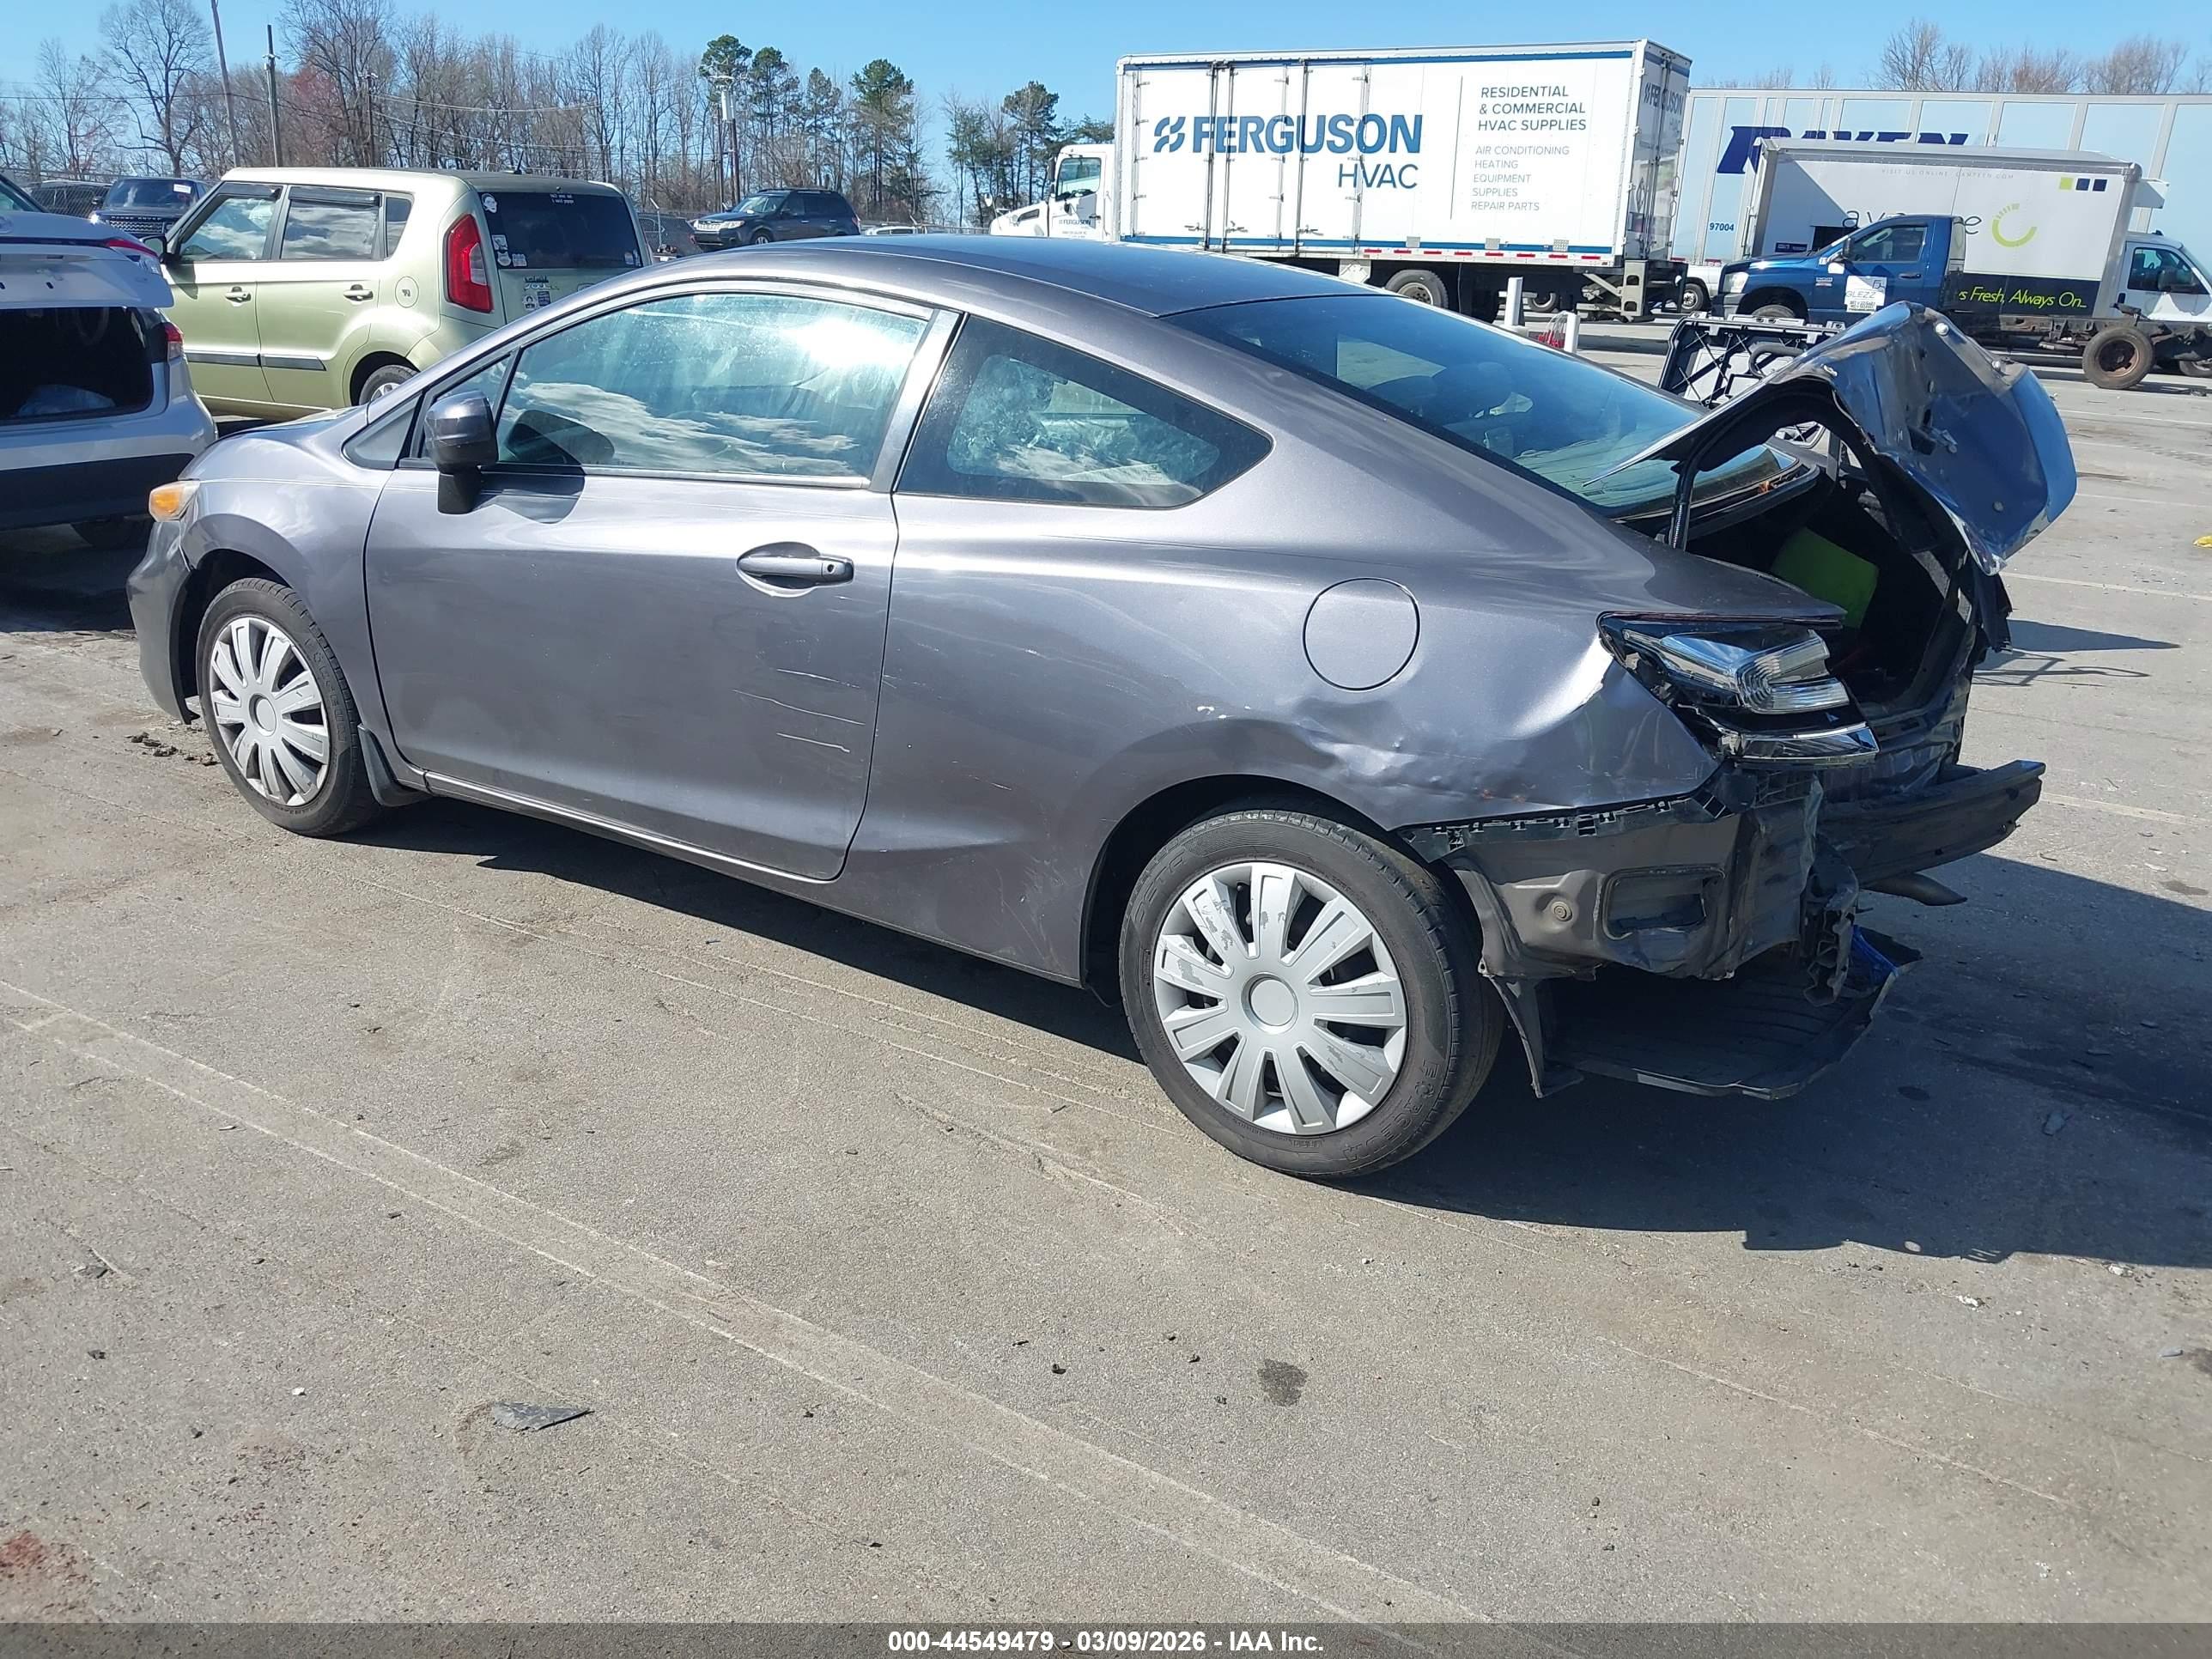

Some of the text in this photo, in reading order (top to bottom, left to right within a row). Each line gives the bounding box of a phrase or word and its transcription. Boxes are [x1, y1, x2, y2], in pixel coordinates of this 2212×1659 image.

[1480, 85, 1570, 99] RESIDENTIAL
[1479, 102, 1586, 114] & COMMERCIAL
[1478, 118, 1587, 131] HVAC SUPPLIES
[1192, 113, 1423, 154] FERGUSON
[1475, 145, 1571, 155] AIR CONDITIONING
[1474, 160, 1519, 169] HEATING
[1338, 163, 1419, 189] HVAC
[1474, 173, 1532, 184] EQUIPMENT
[1472, 187, 1518, 198] SUPPLIES
[1471, 201, 1540, 211] REPAIR PARTS
[1709, 222, 1735, 233] 97004
[1970, 286, 2005, 303] Fresh,
[2008, 289, 2055, 309] Always
